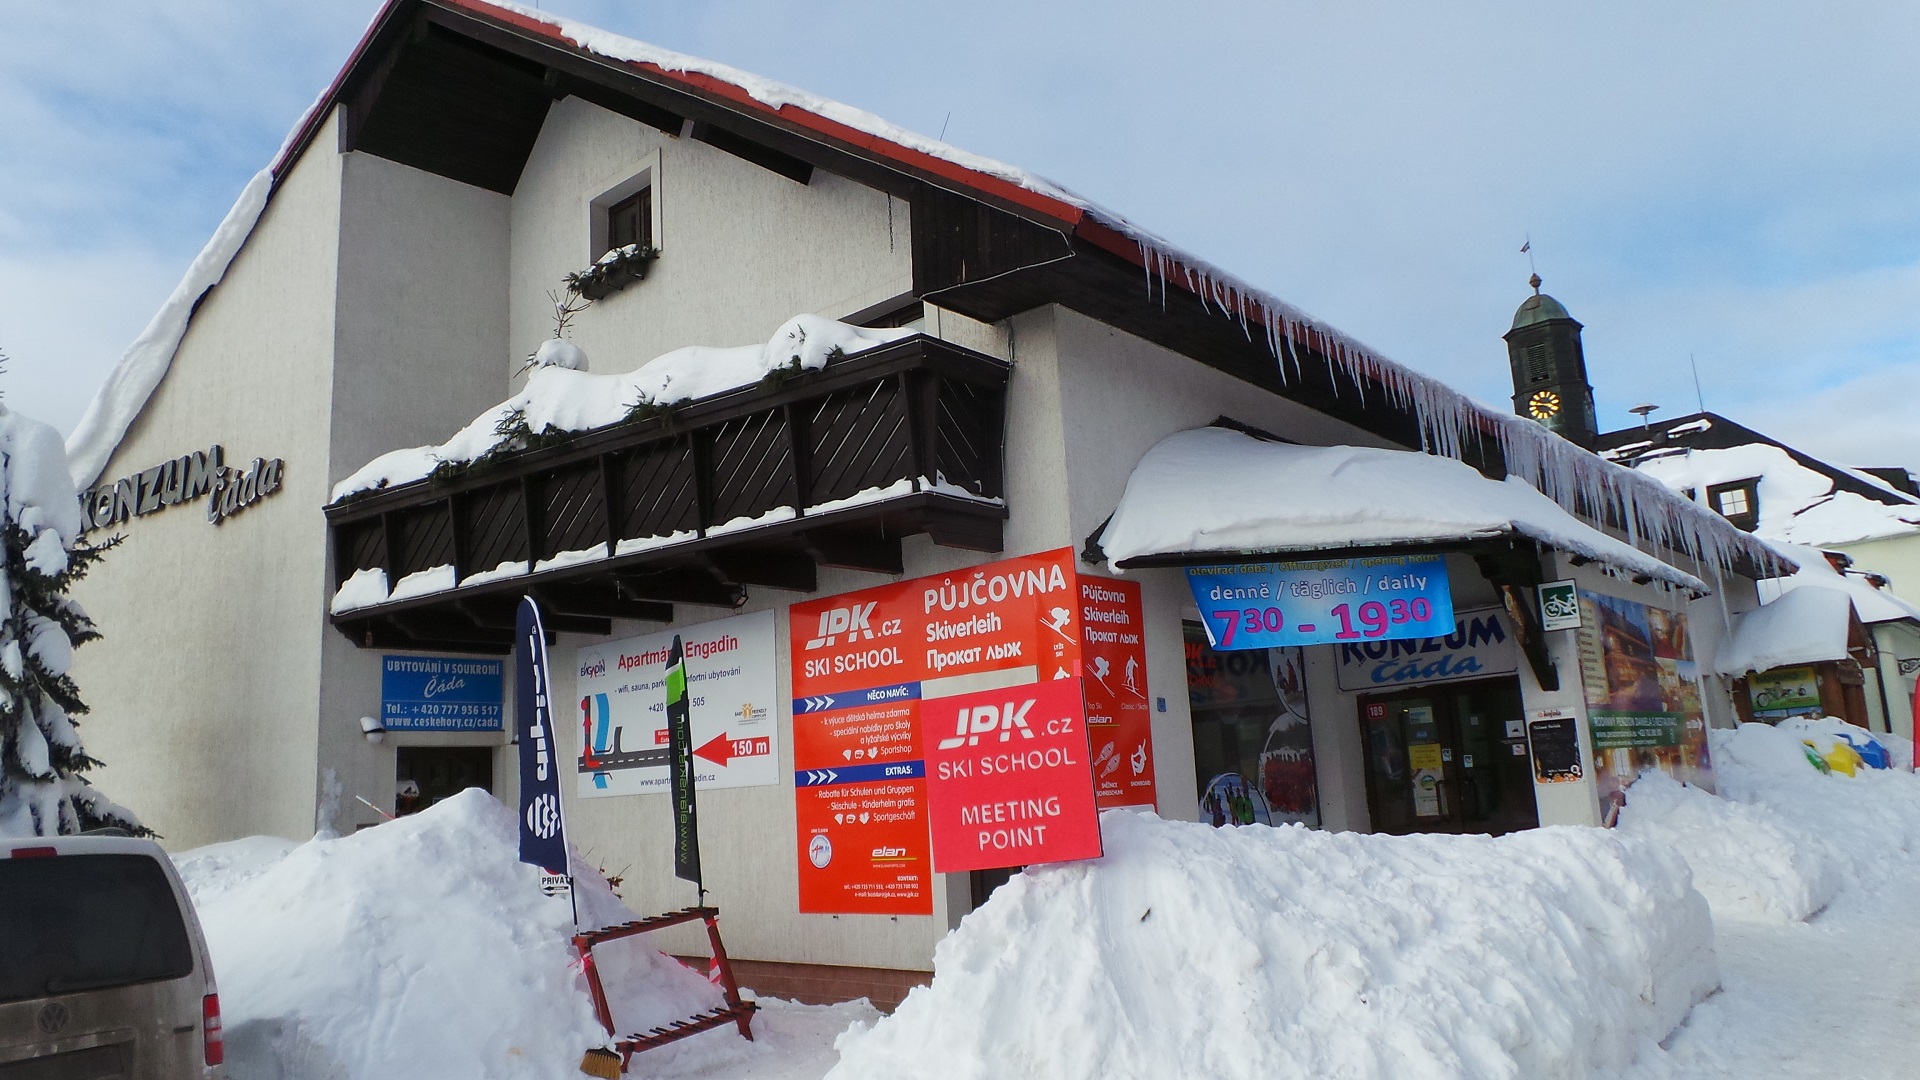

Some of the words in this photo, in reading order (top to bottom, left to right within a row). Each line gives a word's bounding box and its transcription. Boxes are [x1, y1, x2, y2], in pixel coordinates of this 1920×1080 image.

[78, 444, 221, 533] KONZUM
[207, 457, 283, 524] Čáda
[1240, 562, 1268, 574] doba
[1361, 555, 1408, 569] opening
[1408, 553, 1440, 564] hours
[924, 564, 1067, 615] PŮJČOVNA
[1082, 584, 1126, 604] Půjčovna
[1210, 583, 1270, 601] denně
[1290, 578, 1357, 599] täglich
[1378, 573, 1428, 592] daily
[1083, 606, 1130, 625] Skiverleih
[926, 612, 1002, 643] Skiverleih
[1085, 626, 1118, 644] Прокат
[1119, 632, 1139, 644] лыж
[685, 634, 738, 659] Engadin
[805, 656, 831, 678] SKI
[834, 647, 903, 674] SCHOOL
[927, 647, 981, 672] Прокат
[985, 640, 1022, 660] лыж
[387, 660, 441, 673] UBYTOVÁNÍ
[444, 663, 450, 674] V
[452, 663, 500, 676] SOUKROMÍ
[424, 674, 465, 698] Čáda
[651, 678, 666, 691] parki
[708, 666, 741, 681] ubytování
[867, 690, 886, 701] NĚCO
[887, 685, 909, 699] NAVÍC:
[411, 704, 439, 715] +420
[441, 705, 458, 715] 777
[461, 706, 478, 715] 936
[481, 706, 498, 715] 517
[648, 702, 664, 713] +420
[692, 697, 705, 707] 505
[886, 707, 910, 719] zdarma
[1370, 706, 1384, 717] 189
[884, 722, 895, 733] pro
[1088, 714, 1113, 724] elan
[732, 741, 753, 756] 150
[756, 741, 768, 754] m
[880, 744, 912, 757] Sportshop
[885, 765, 913, 777] EXTRAS:
[937, 759, 973, 780] SKI
[980, 747, 1077, 775] SCHOOL
[818, 787, 840, 799] Rabatte
[850, 785, 873, 797] Schulen
[873, 785, 886, 796] und
[887, 784, 914, 797] Gruppen
[831, 801, 857, 811] Skischule
[862, 799, 897, 809] Kinderhelm
[897, 798, 915, 809] gratis
[961, 796, 1061, 826] MEETING
[873, 810, 916, 823] Sportgeschäft
[979, 825, 1047, 850] POINT
[871, 846, 907, 857] elan
